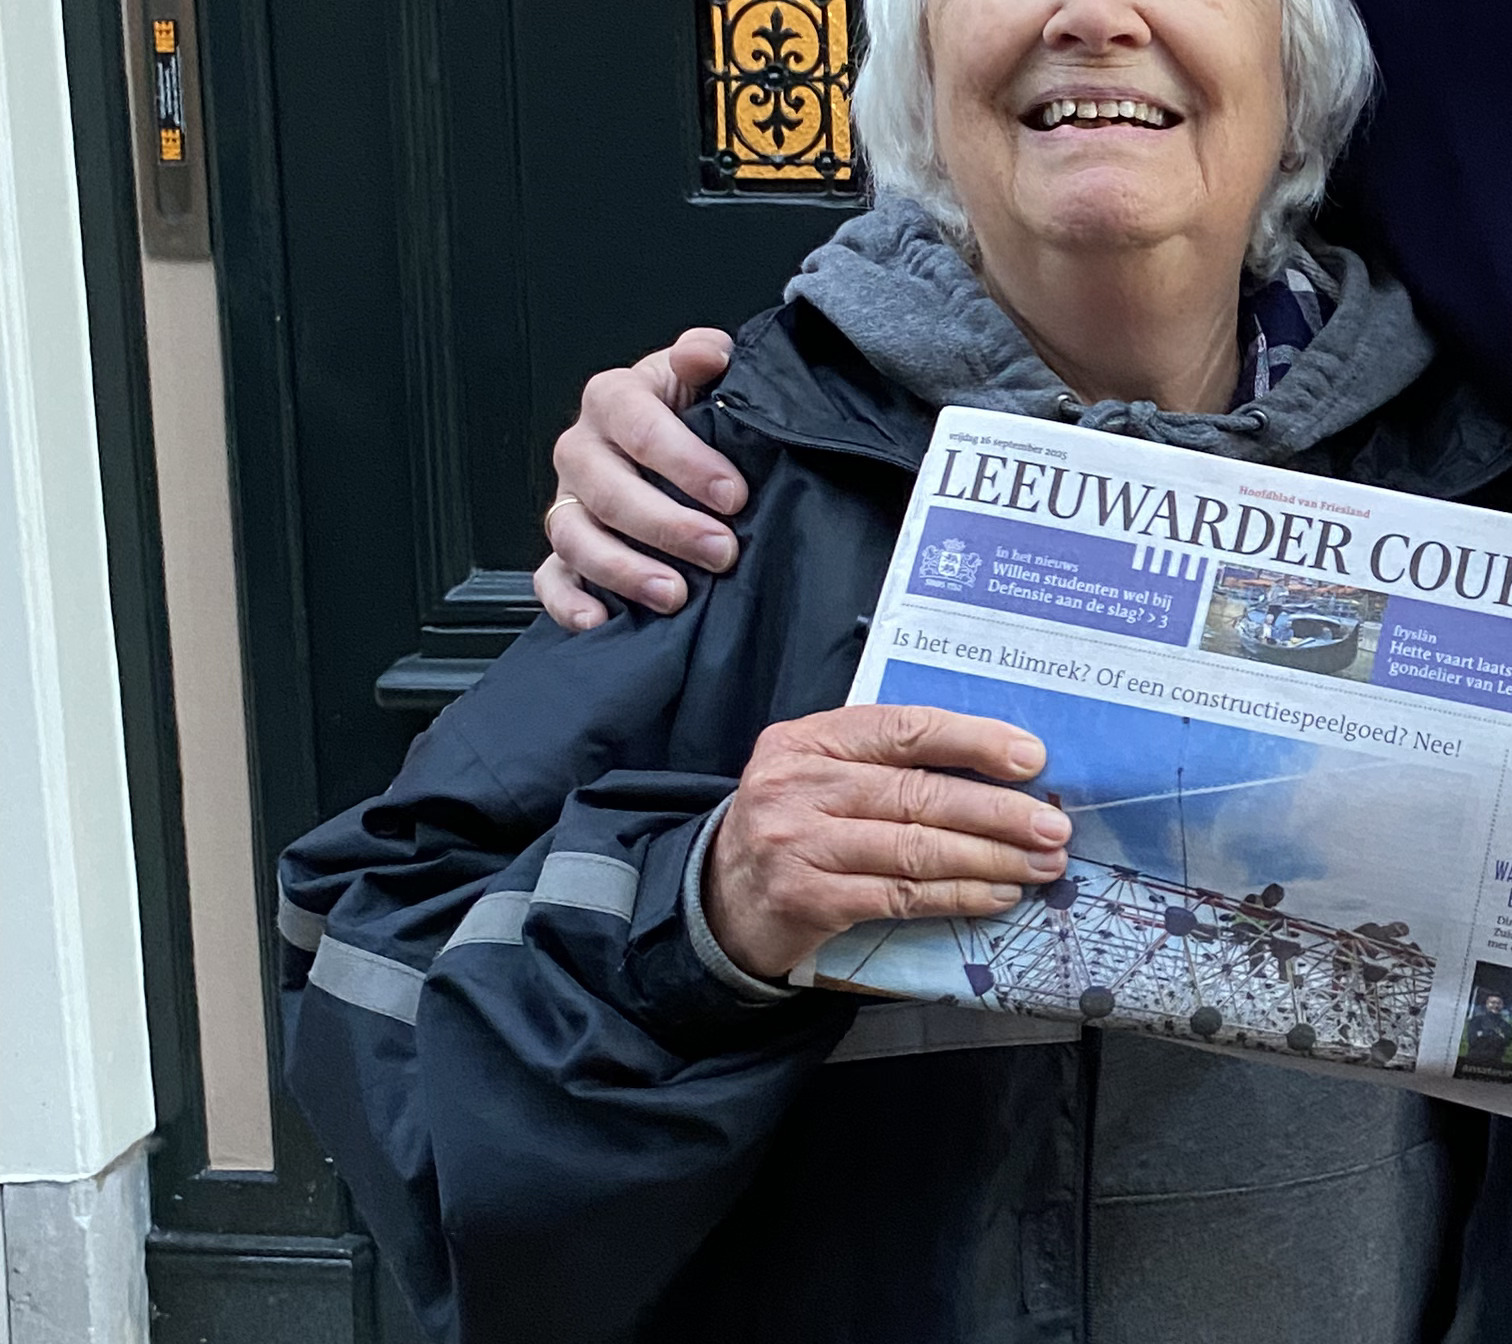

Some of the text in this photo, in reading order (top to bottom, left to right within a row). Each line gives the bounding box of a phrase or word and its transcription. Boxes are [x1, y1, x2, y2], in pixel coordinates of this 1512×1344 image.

[993, 439, 1043, 454] september
[933, 449, 1351, 575] LEEUWARDER
[1239, 485, 1371, 518] Hoofdblad van Friesland
[996, 546, 1079, 573] in het nieuws
[992, 562, 1173, 611] Willen studenten wel bij
[987, 579, 1052, 603] Defensie
[1055, 593, 1082, 609] aan
[1086, 596, 1104, 614] de
[1107, 602, 1144, 624] slag?
[1158, 615, 1168, 629] 3
[1390, 641, 1431, 663] Hette
[1436, 651, 1473, 671] vaart
[893, 627, 1462, 758] Is het een klimrek? Of een constructiespeelgoed? Nee!
[1466, 677, 1493, 693] van
[1487, 940, 1508, 951] met
